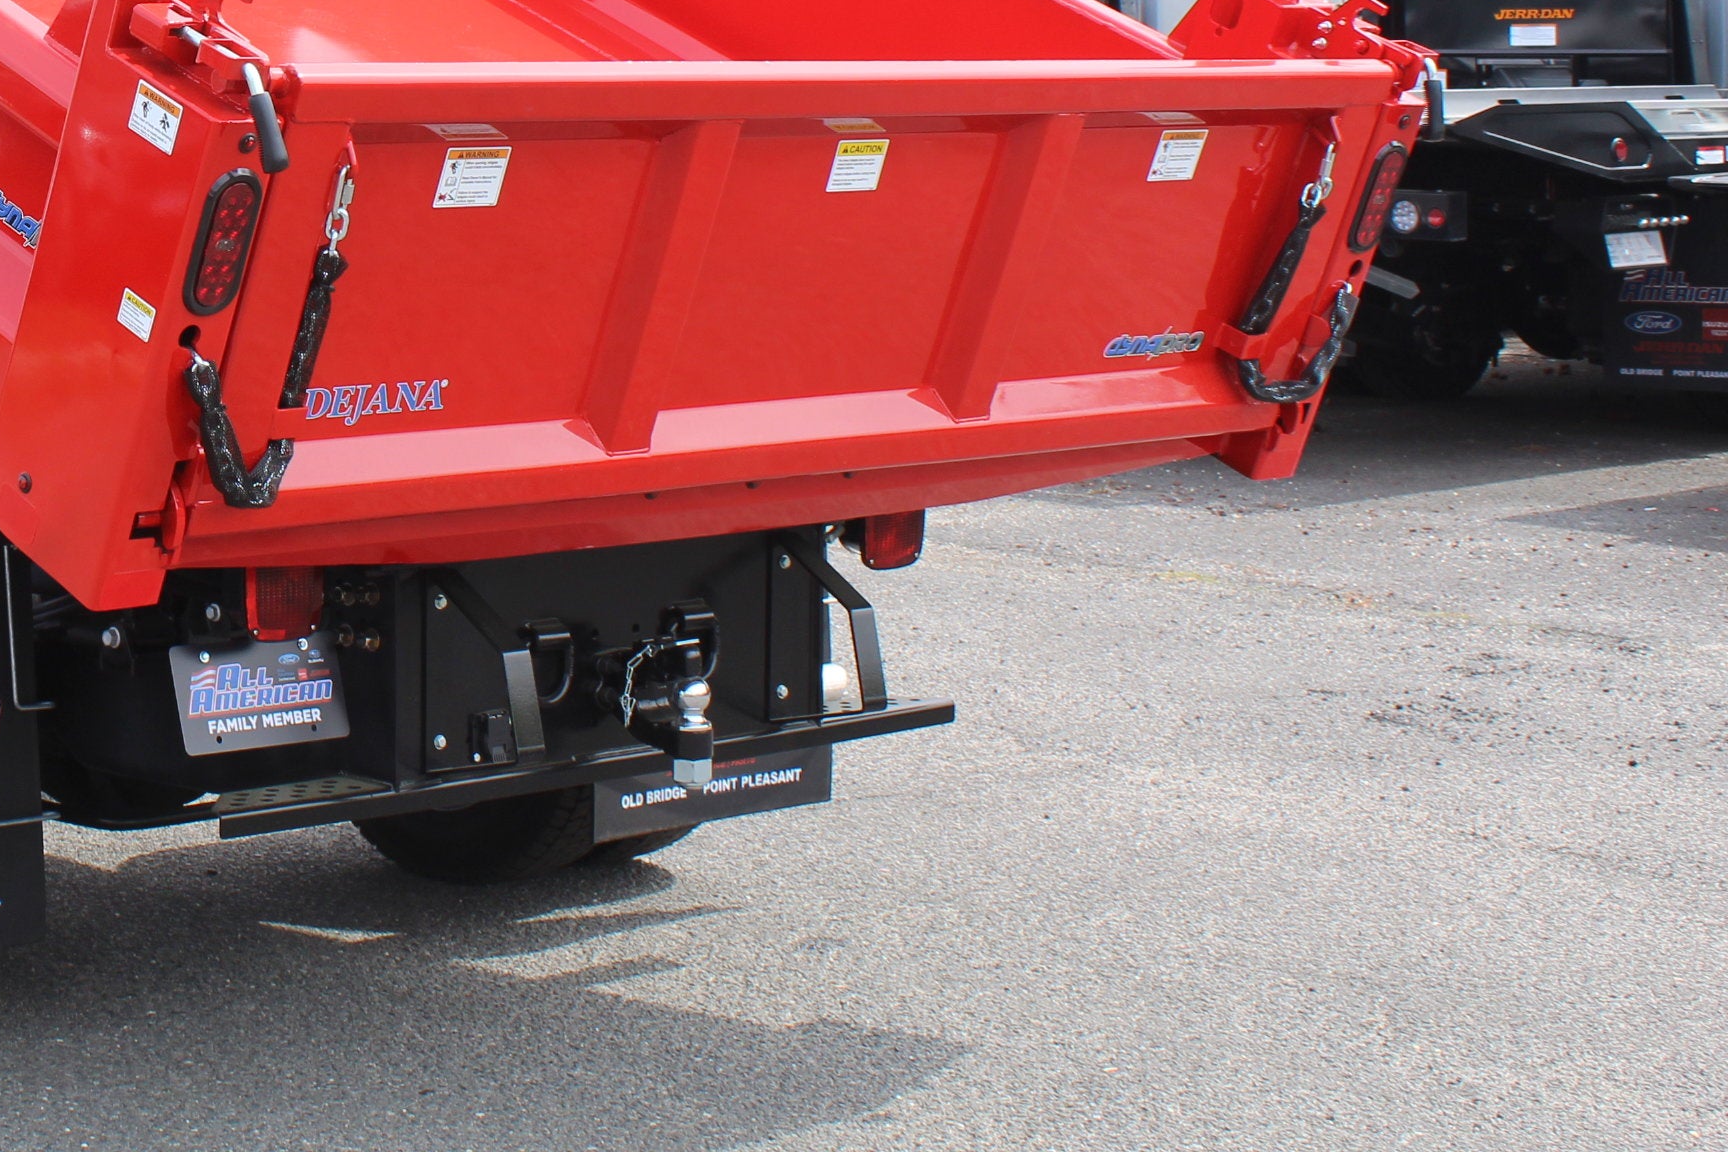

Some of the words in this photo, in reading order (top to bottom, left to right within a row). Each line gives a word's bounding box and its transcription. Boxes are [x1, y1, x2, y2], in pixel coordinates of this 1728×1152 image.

[1494, 9, 1574, 20] JERR-DAN
[465, 150, 501, 158] WARNING
[849, 144, 883, 154] CAUTION
[1634, 314, 1674, 330] Ford
[216, 663, 274, 692] ALL
[189, 679, 334, 716] AMERICAN
[207, 714, 258, 735] FAMILY
[262, 707, 322, 729] MEMBER
[621, 793, 644, 809] OLD
[646, 786, 687, 805] BRIDGE
[703, 776, 739, 795] POINT
[740, 767, 803, 789] PLEASANT
